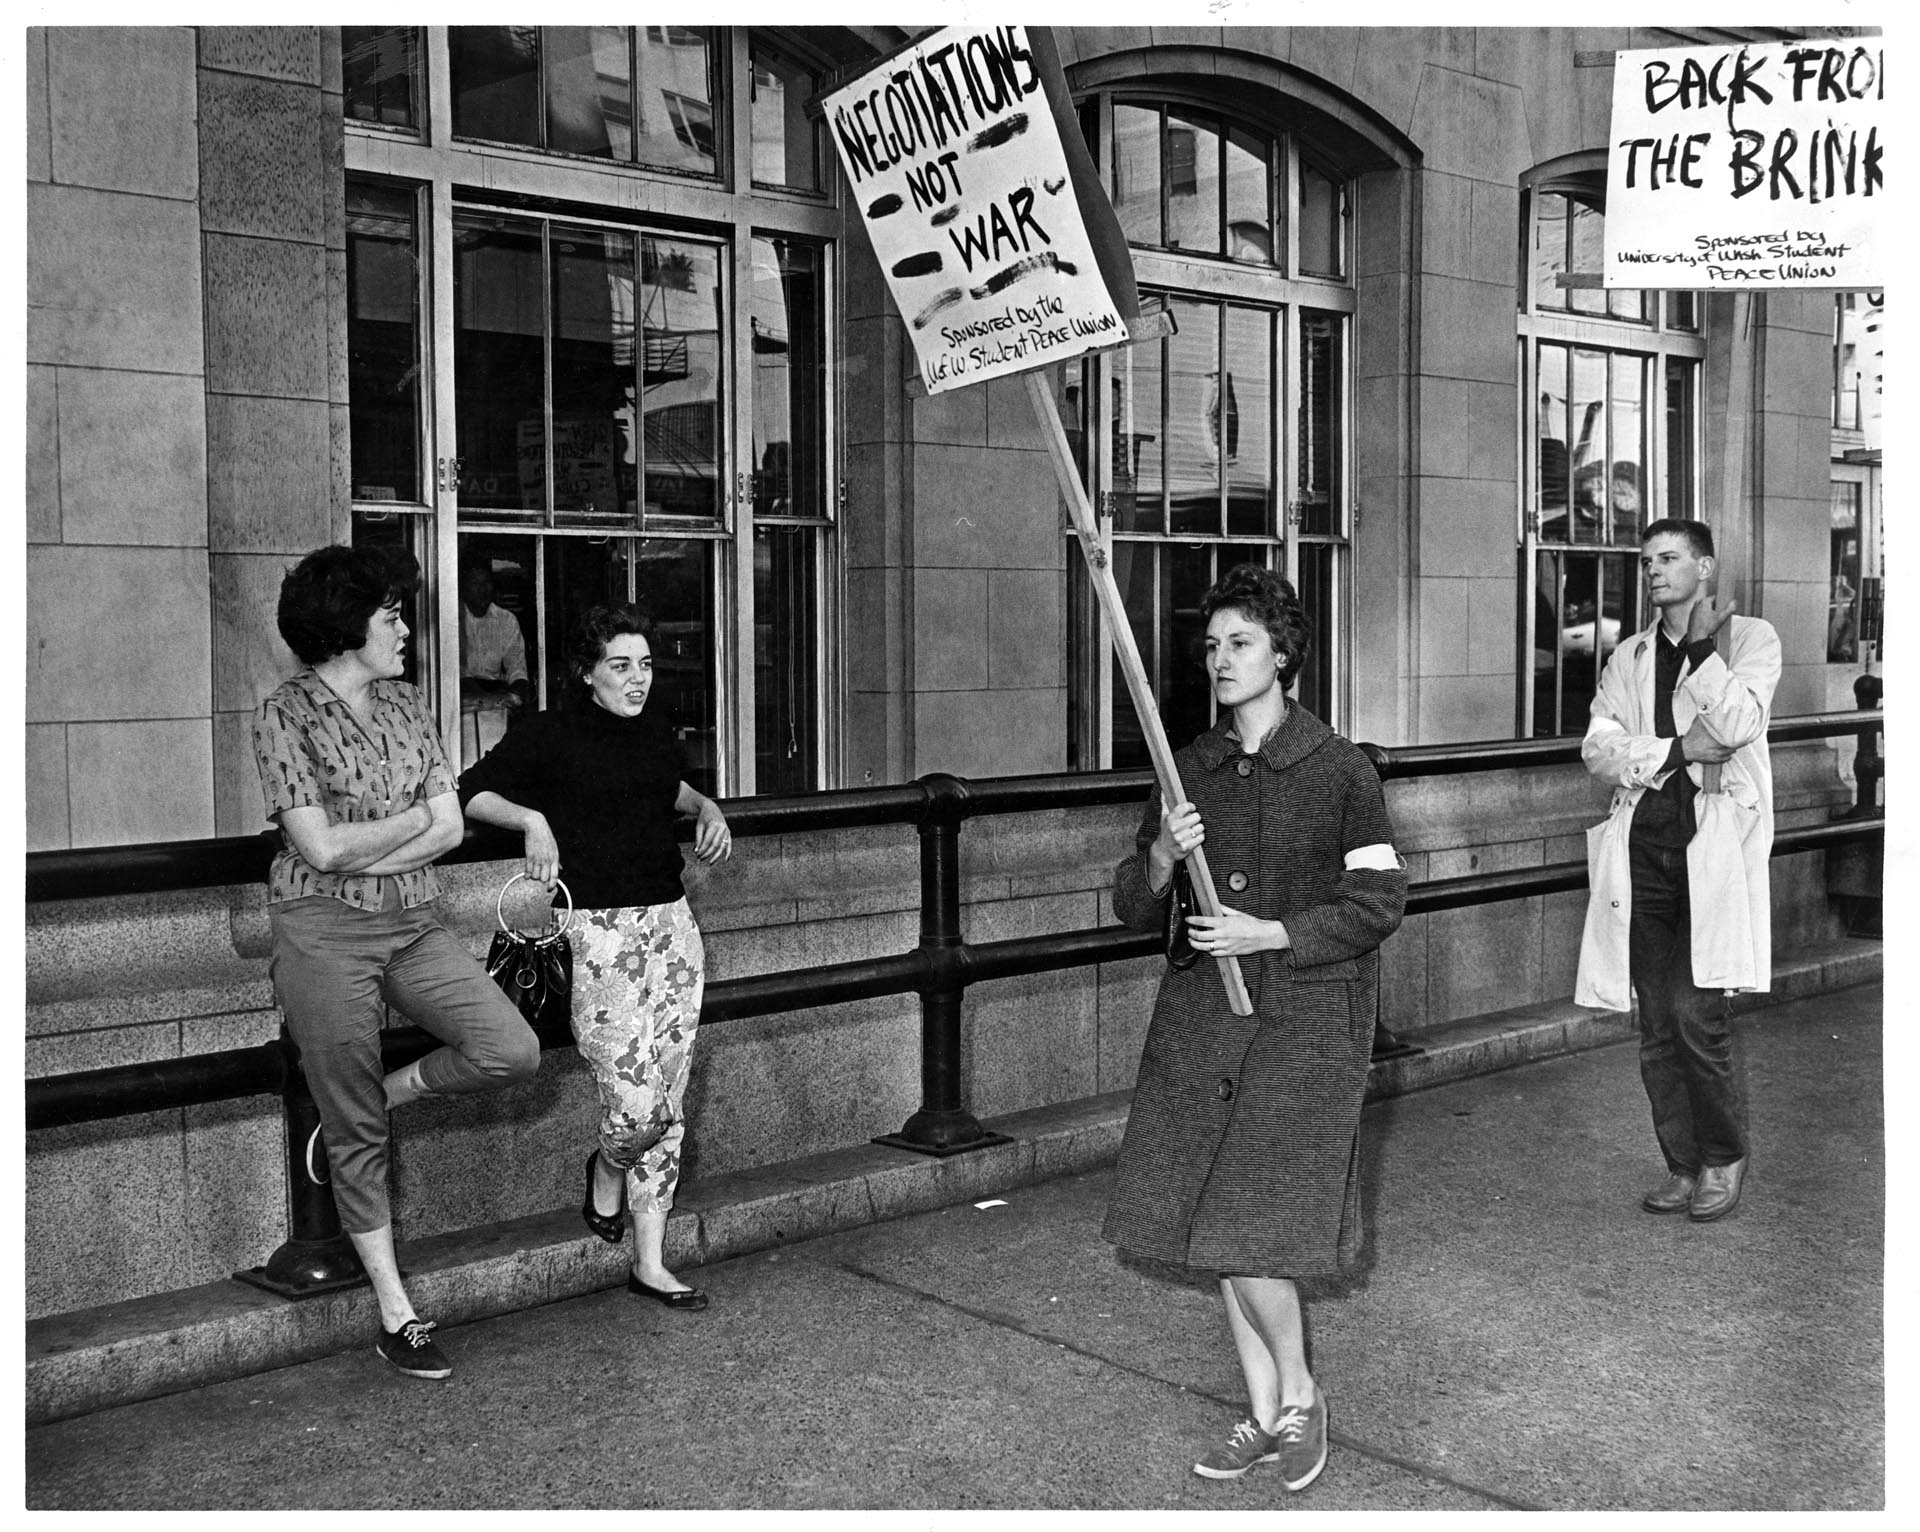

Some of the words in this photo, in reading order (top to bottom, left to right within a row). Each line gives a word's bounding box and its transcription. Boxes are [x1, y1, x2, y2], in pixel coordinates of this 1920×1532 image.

[834, 26, 1040, 184] NEGOTIATIONS
[1643, 46, 1774, 114] BACK
[1783, 46, 1883, 103] FRO
[906, 151, 963, 213] NOT
[1619, 133, 1711, 191] THE
[949, 186, 1051, 273] WAR
[1797, 230, 1826, 247] by
[1706, 265, 1776, 281] PEACE
[1015, 306, 1043, 327] by
[1036, 295, 1064, 318] the
[1028, 326, 1071, 352] PEACE
